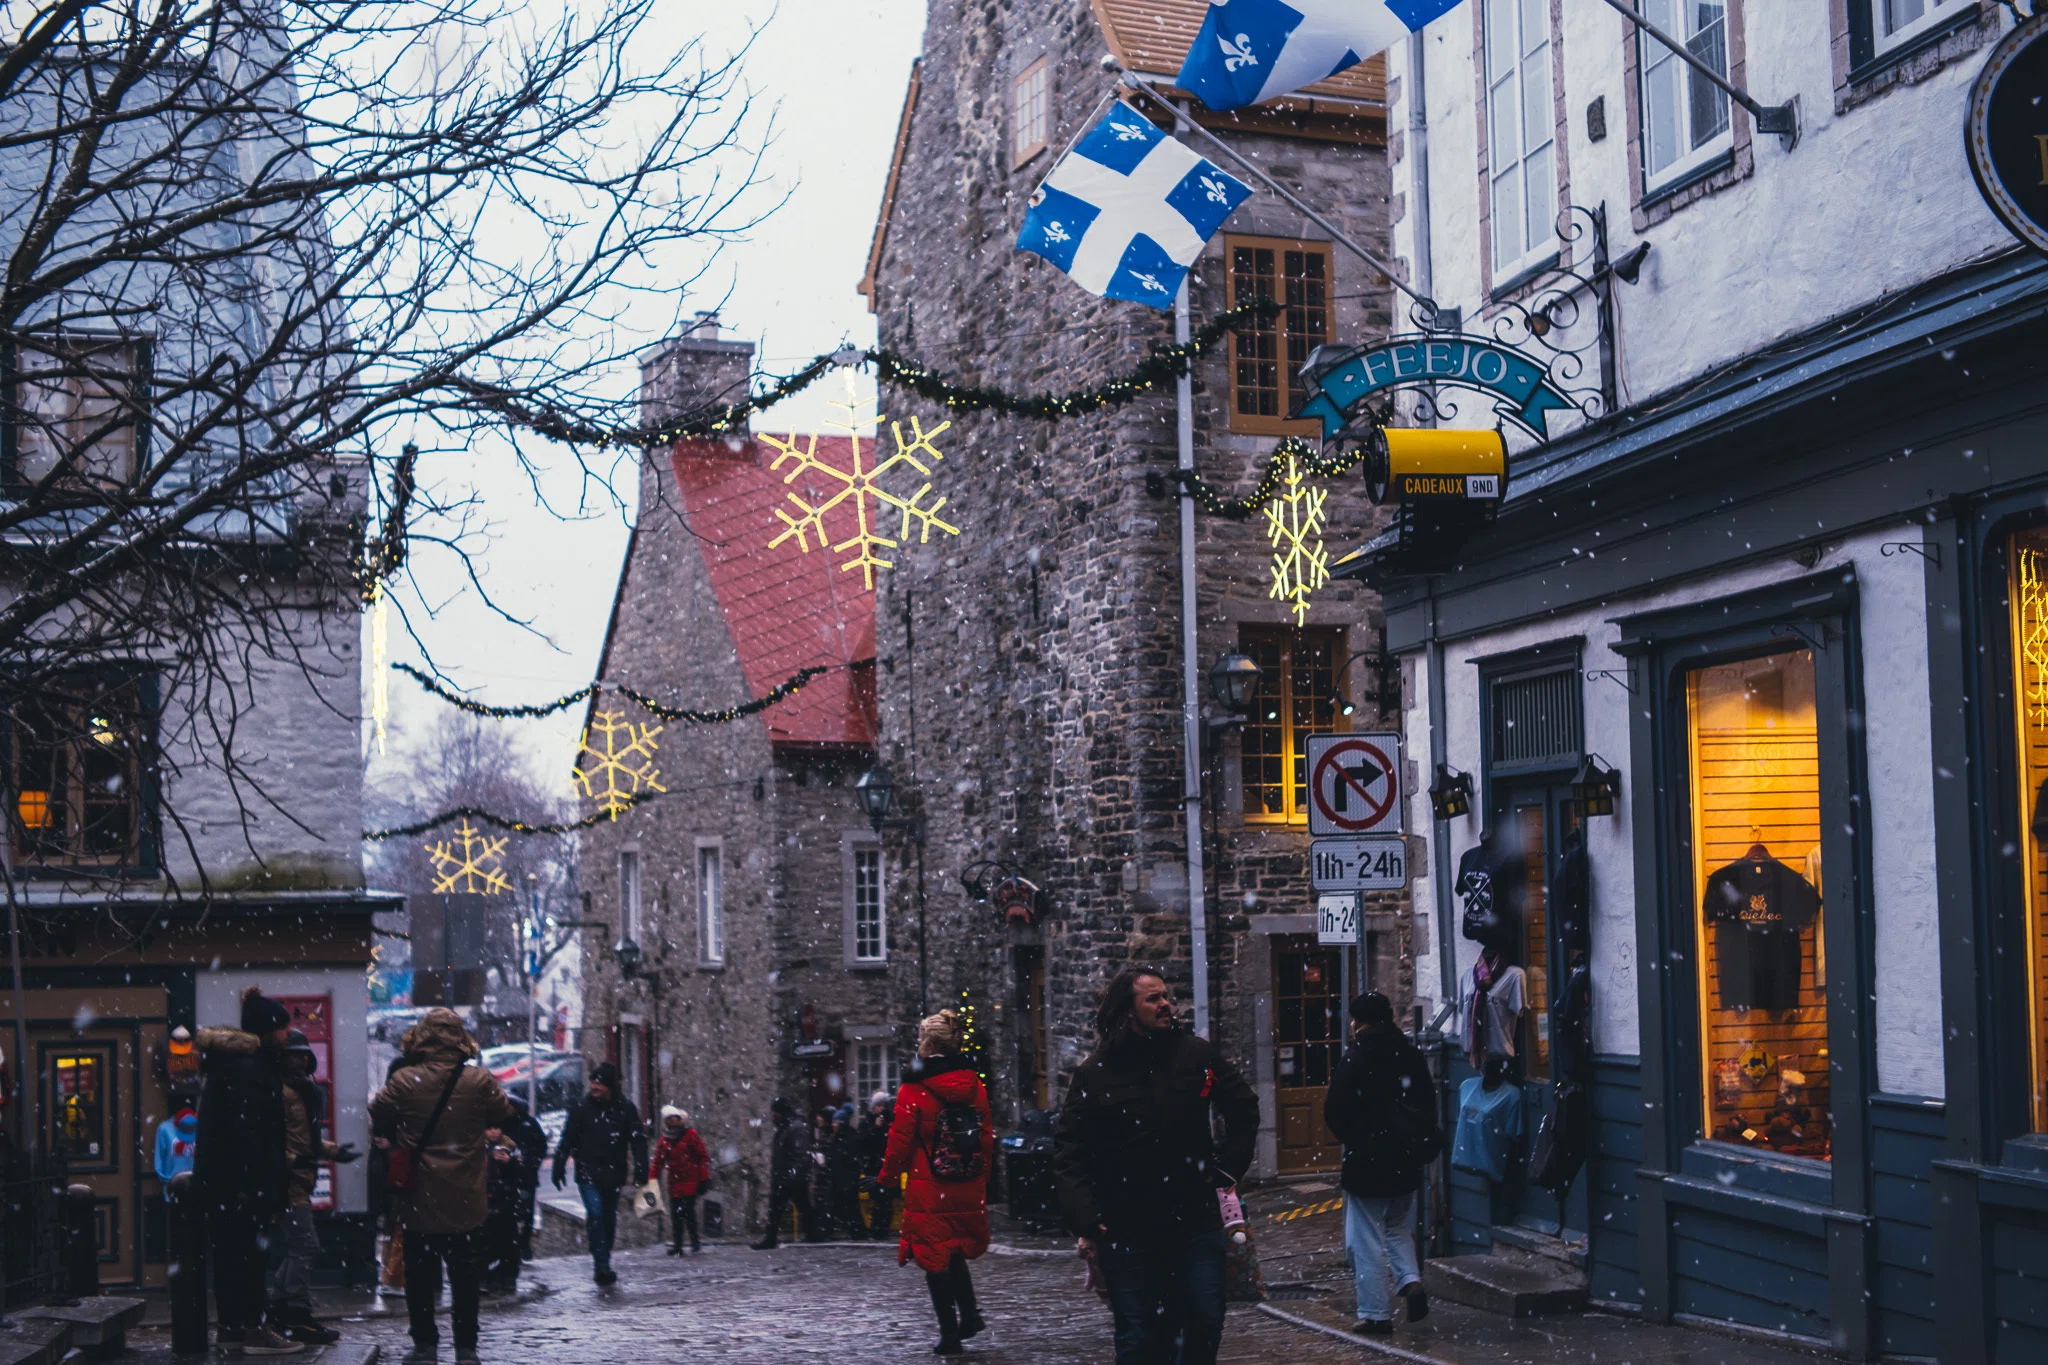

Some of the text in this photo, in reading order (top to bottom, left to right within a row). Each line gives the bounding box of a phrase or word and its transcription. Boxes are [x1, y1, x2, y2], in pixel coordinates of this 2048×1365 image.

[1361, 342, 1508, 387] FEEJO
[1405, 477, 1493, 495] CADEAUX 9ND
